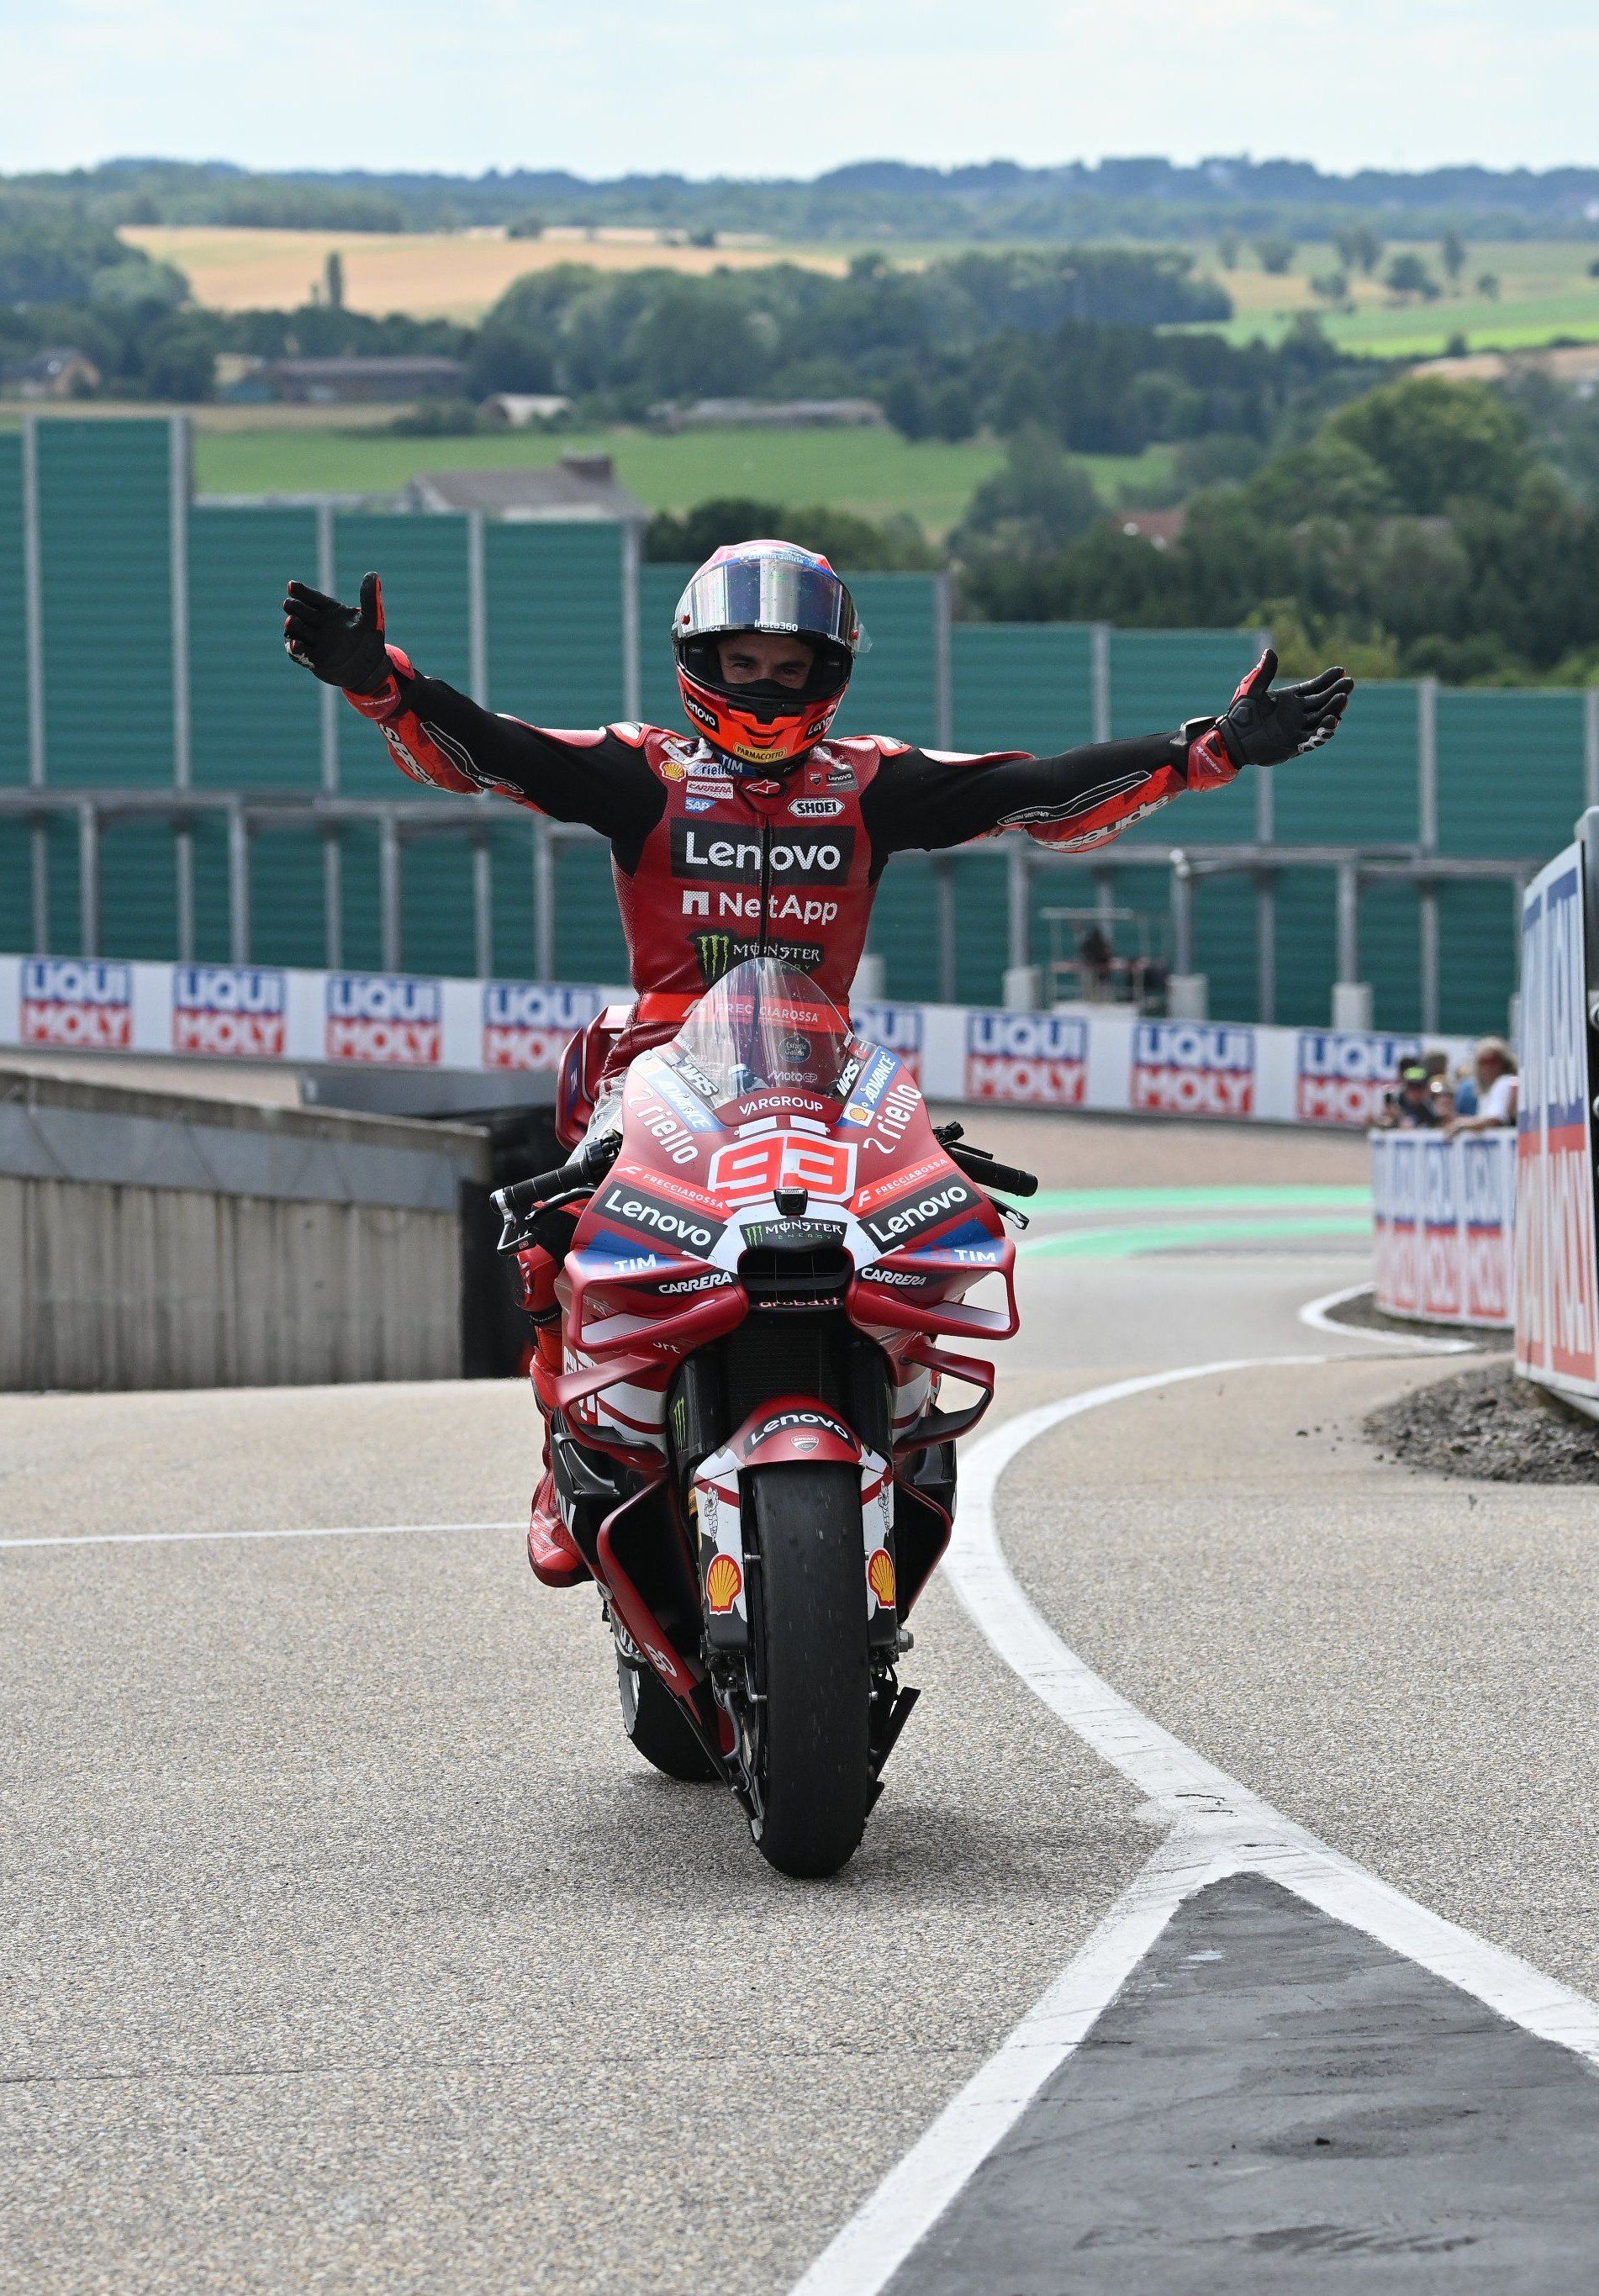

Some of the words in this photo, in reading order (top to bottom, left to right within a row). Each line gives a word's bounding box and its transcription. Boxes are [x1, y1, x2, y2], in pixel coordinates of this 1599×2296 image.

[684, 694, 716, 726] Lenovo
[721, 753, 743, 773] TIM
[736, 745, 785, 760] PARMACOTTO
[689, 784, 732, 793] CARRERA
[797, 800, 836, 814] SHOEI
[685, 831, 842, 871] Lenovo
[718, 892, 838, 926] NetApp
[768, 1069, 817, 1084] MotoGP
[836, 1058, 860, 1097] WRS
[864, 1054, 896, 1105] ADVANCE
[739, 1095, 824, 1116] VARGROUP
[877, 1084, 922, 1140] riello
[636, 1104, 699, 1164] riello
[707, 1130, 858, 1208] 93
[874, 1158, 948, 1196] FRECCIAROSSA
[642, 1174, 724, 1210] FRECCIAROSSA
[604, 1189, 711, 1246] Lenovo
[765, 1220, 844, 1234] MONSTER
[868, 1186, 968, 1243] Lenovo
[614, 1252, 657, 1272] TIM
[953, 1248, 996, 1262] TIM
[657, 1271, 733, 1294] CARRERA
[860, 1267, 927, 1286] CARRERA
[759, 1296, 841, 1308] aruba.it
[751, 1412, 849, 1445] Lenovo
